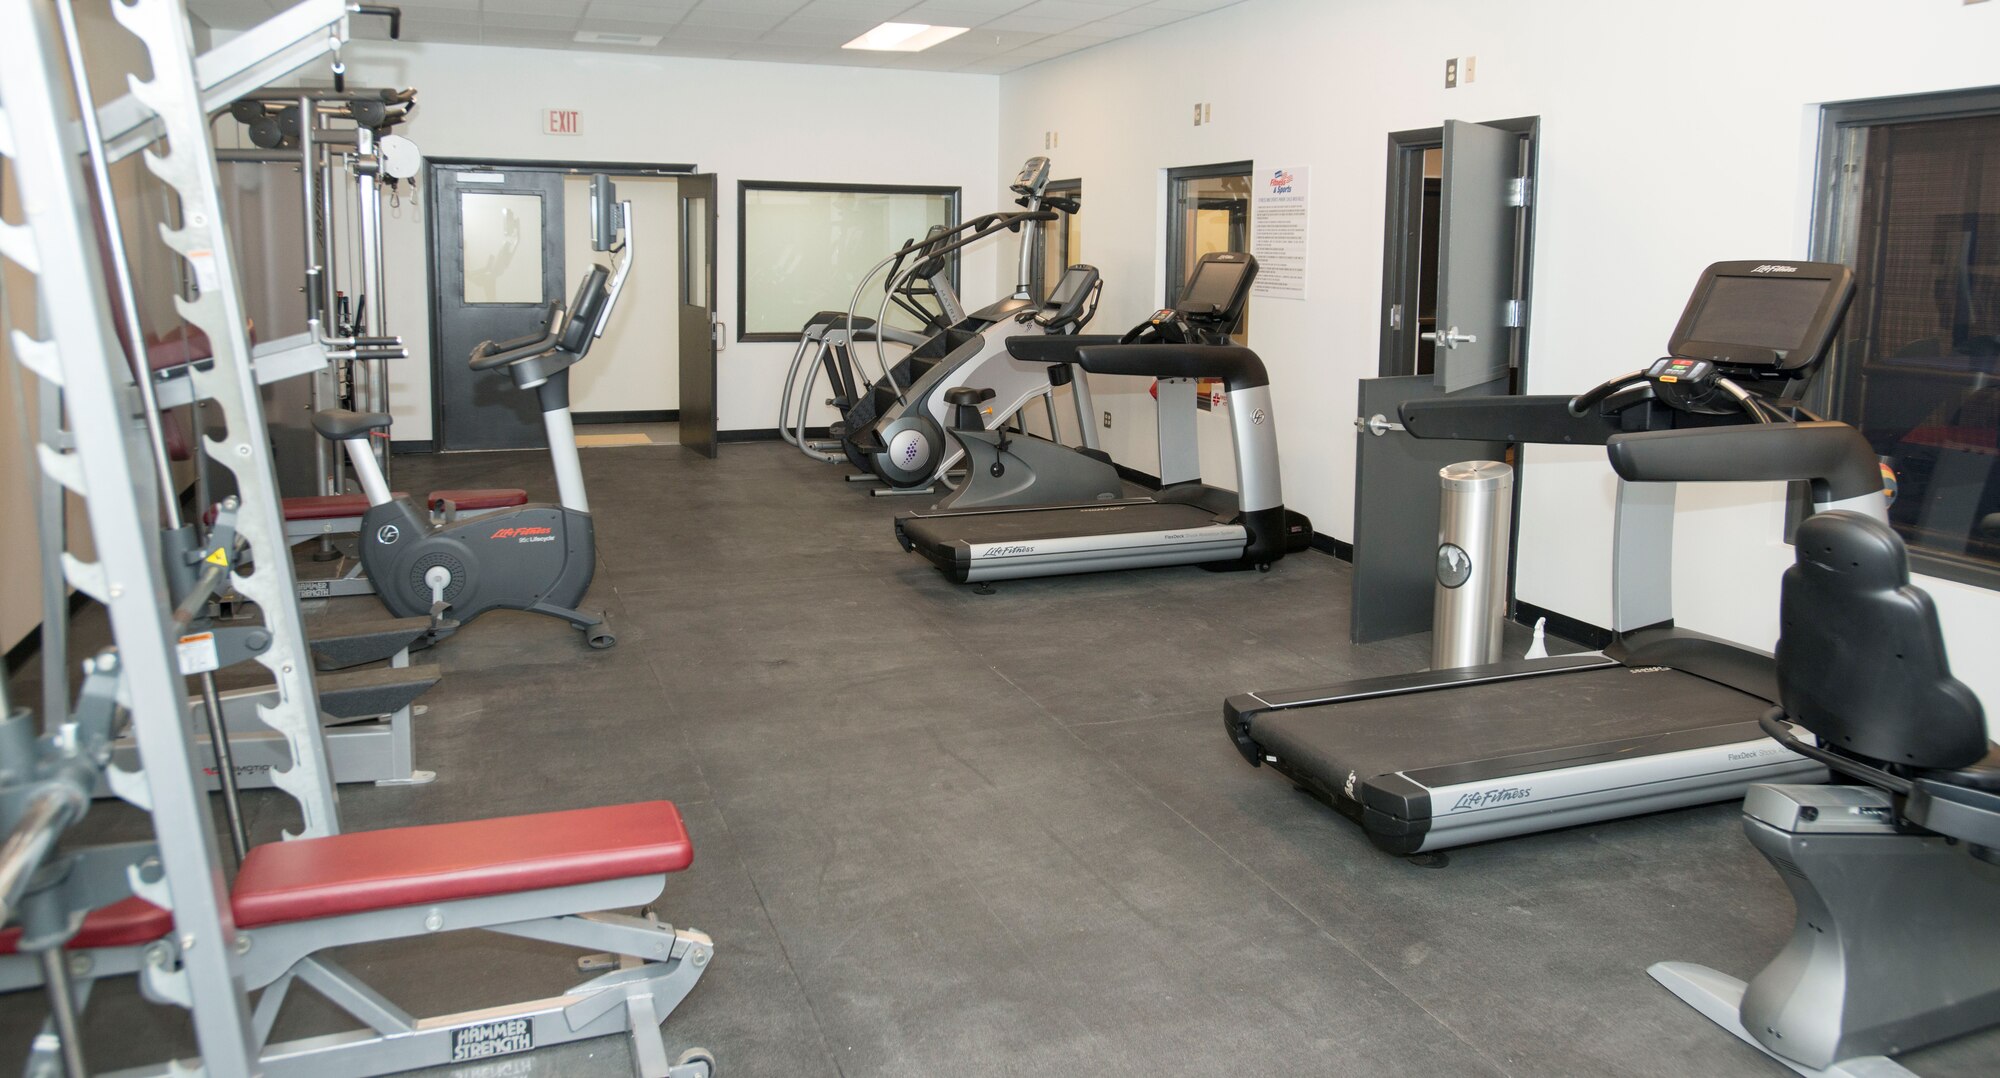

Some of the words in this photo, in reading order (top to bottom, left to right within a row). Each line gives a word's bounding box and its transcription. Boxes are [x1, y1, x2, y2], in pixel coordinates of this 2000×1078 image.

[550, 110, 578, 133] EXIT
[1277, 186, 1292, 194] Sports
[1727, 750, 1758, 761] FlexDeck
[458, 1020, 527, 1045] HAMMER
[454, 1034, 530, 1060] STRENGTH
